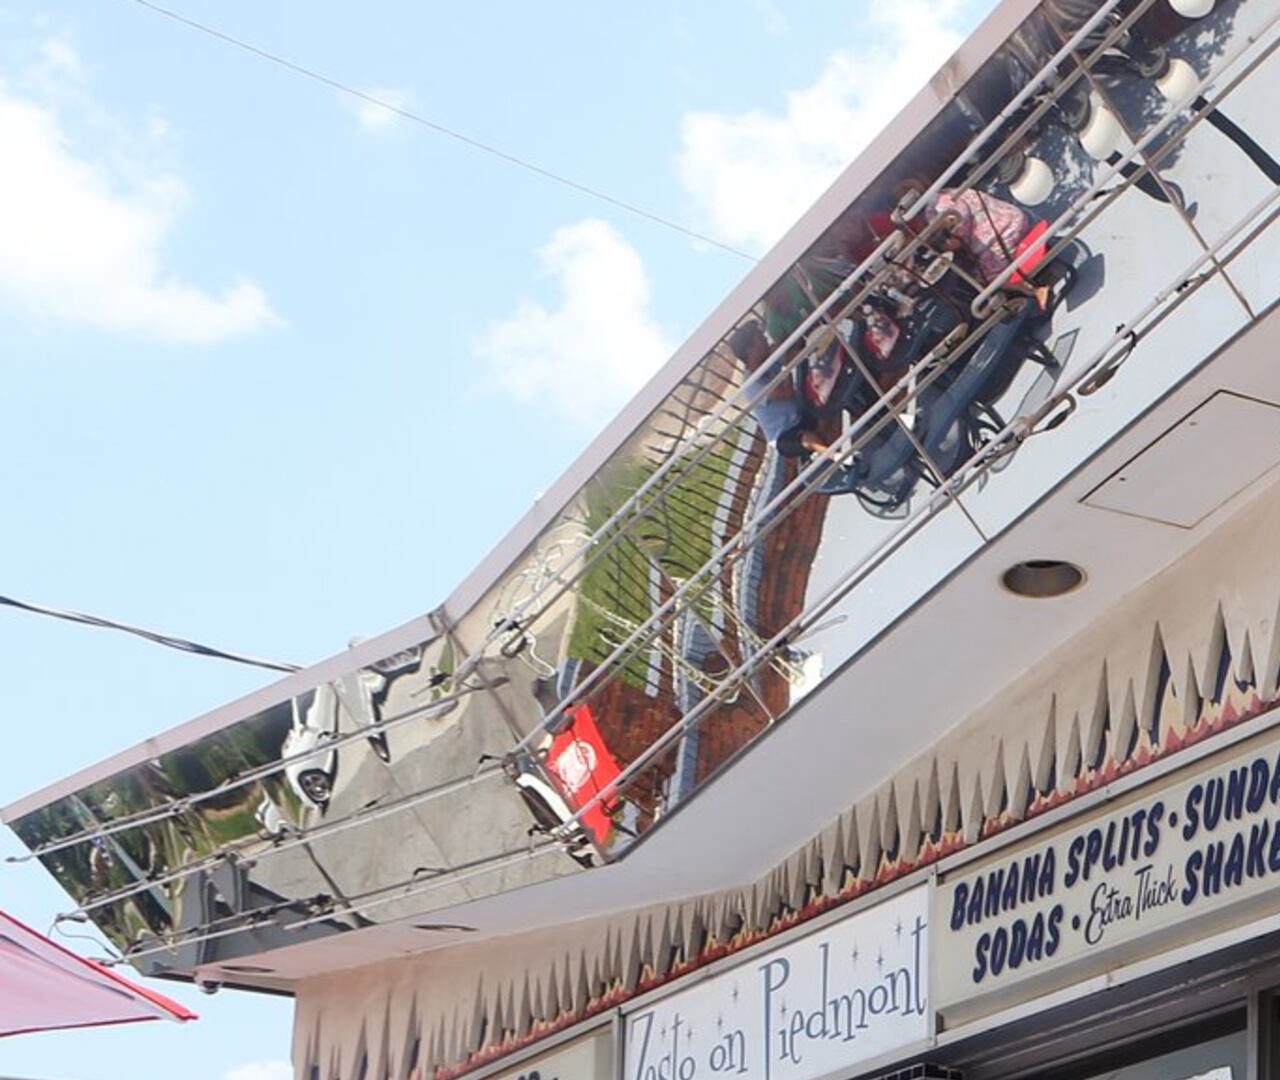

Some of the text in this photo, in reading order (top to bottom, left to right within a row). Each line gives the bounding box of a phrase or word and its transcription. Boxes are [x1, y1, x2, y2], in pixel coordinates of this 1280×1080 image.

[950, 846, 1056, 933] BANANA
[1064, 800, 1165, 889] SPLITS
[972, 903, 1063, 984] SODAS
[1085, 882, 1133, 945] Extra
[1134, 864, 1181, 922] Thick
[709, 1028, 748, 1074] on
